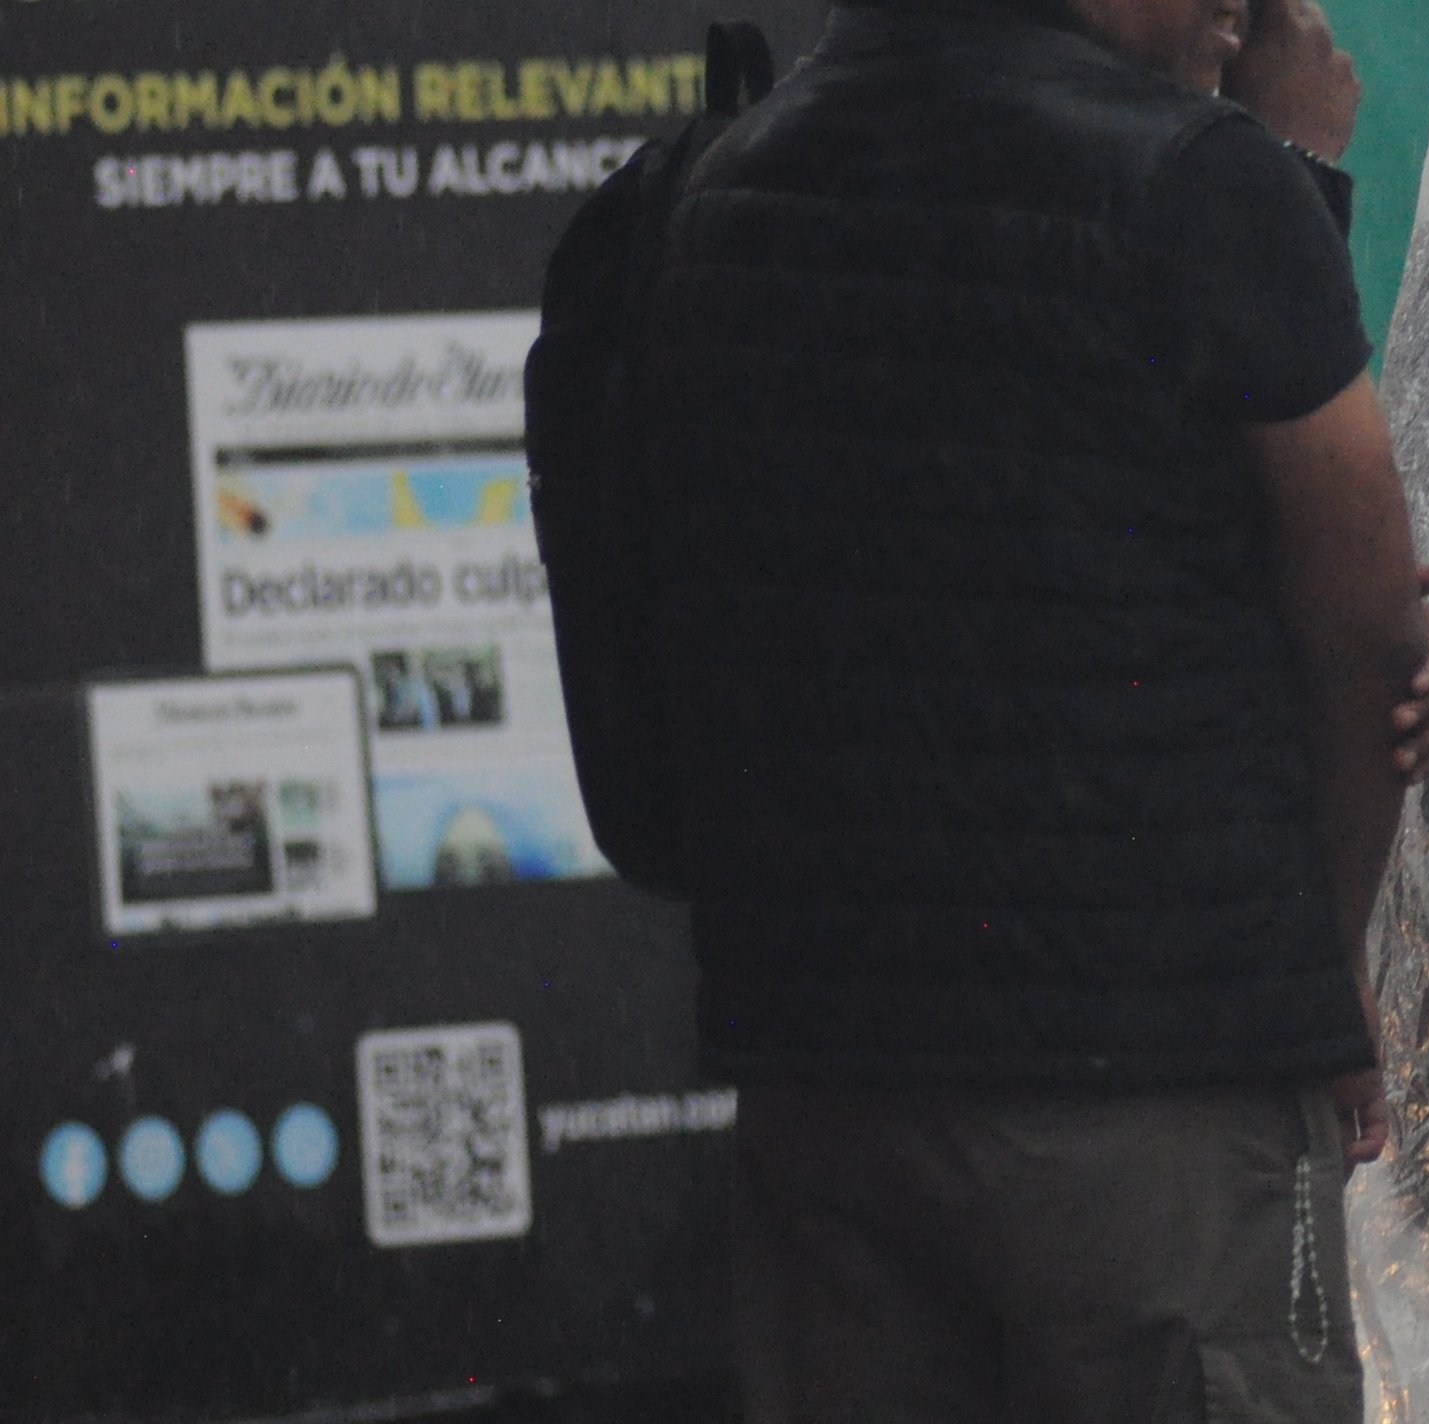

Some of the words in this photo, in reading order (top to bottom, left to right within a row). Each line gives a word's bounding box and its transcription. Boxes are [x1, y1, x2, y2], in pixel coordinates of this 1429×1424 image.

[414, 55, 706, 122] RELEVANT
[95, 150, 298, 210] SIEMPRE
[307, 147, 347, 202] A
[353, 142, 418, 199] TU
[221, 559, 441, 618] Declarado
[454, 552, 550, 613] culp
